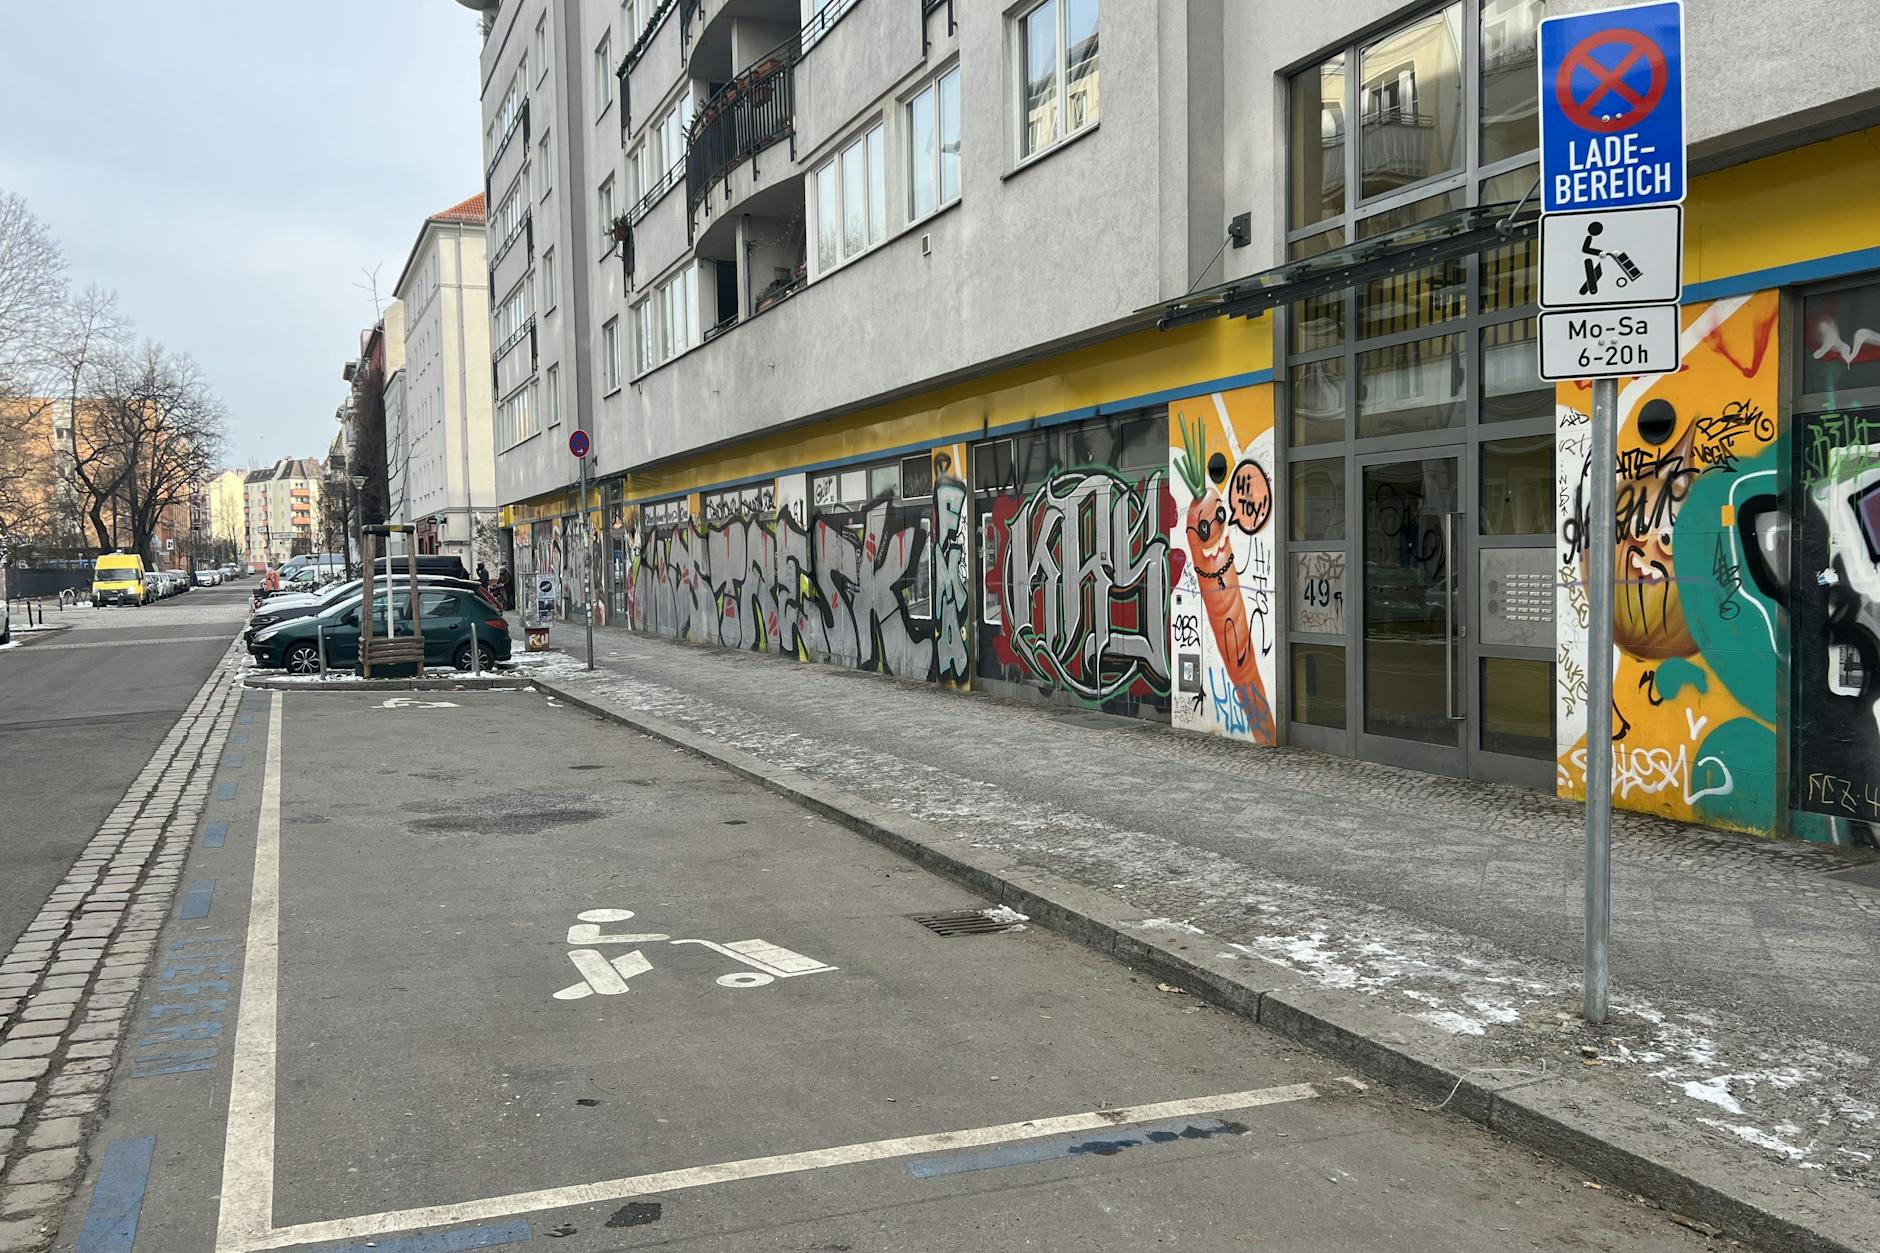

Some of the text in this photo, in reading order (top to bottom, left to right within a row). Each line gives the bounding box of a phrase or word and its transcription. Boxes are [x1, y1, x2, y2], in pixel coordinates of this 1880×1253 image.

[1569, 133, 1655, 171] LADE-
[1555, 162, 1671, 205] BEREICH
[1568, 316, 1648, 340] Mo-Sa
